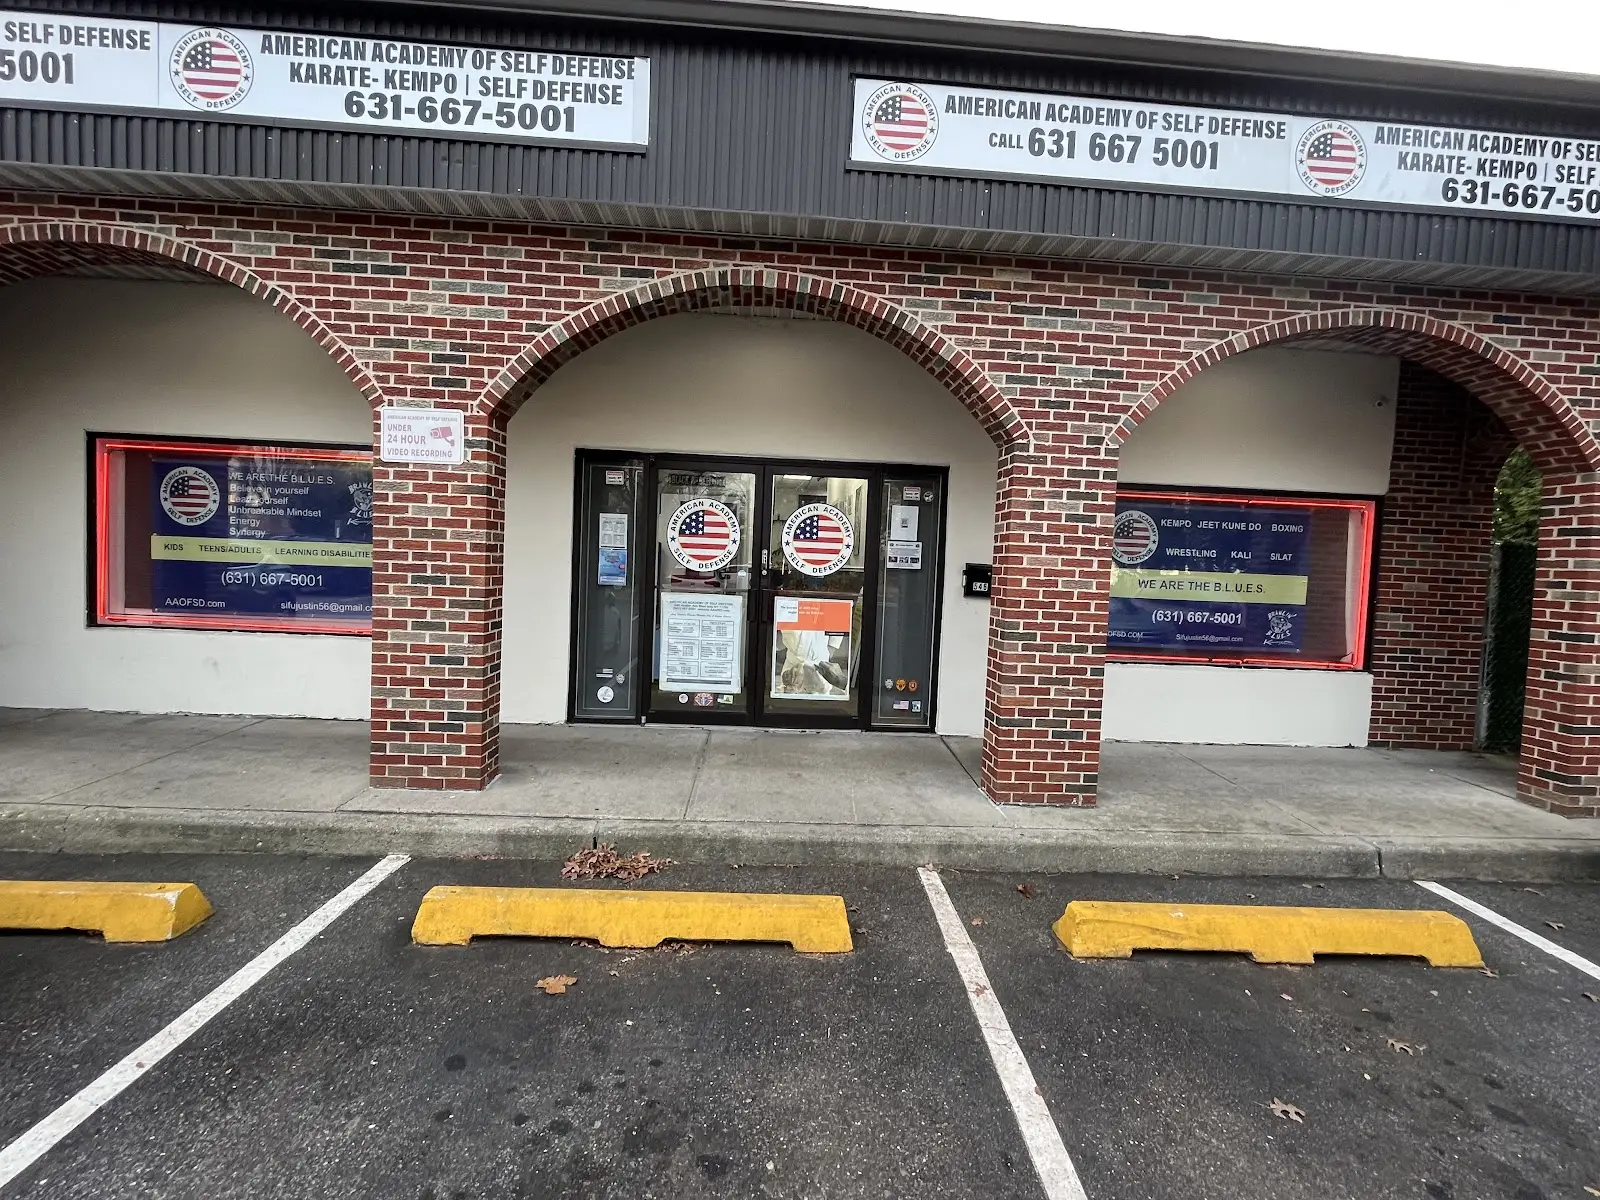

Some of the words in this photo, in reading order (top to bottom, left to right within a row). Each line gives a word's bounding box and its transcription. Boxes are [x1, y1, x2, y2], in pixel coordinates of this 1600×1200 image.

[4, 21, 54, 44] SELF
[59, 24, 151, 50] DEFENSE
[173, 30, 211, 65] AMERICAN
[216, 32, 250, 69] ACADEMY
[260, 34, 367, 61] AMERICAN
[371, 42, 468, 68] ACADEMY
[472, 49, 497, 70] OF
[500, 51, 548, 74] SELF
[552, 55, 635, 80] DEFENSE
[0, 50, 75, 84] 5001
[289, 61, 379, 88] KARATE-
[384, 68, 458, 95] KEMPO
[478, 75, 528, 99] SELF
[532, 79, 623, 105] DEFENSE
[178, 83, 199, 103] SELF
[206, 86, 246, 108] DEFENSE
[866, 85, 902, 118] AMERICAN
[906, 86, 936, 122] ACADEMY
[344, 90, 575, 132] 631-667-5001
[944, 94, 1042, 120] AMERICAN
[1045, 102, 1133, 127] ACADEMY
[1135, 110, 1158, 130] OF
[1161, 112, 1205, 133] SELF
[1208, 116, 1287, 140] DEFENSE
[869, 135, 888, 153] SELF
[894, 138, 931, 159] DEFENSE
[988, 132, 1024, 149] CALL
[1028, 127, 1077, 159] 631
[1088, 132, 1142, 163] 667
[1152, 137, 1219, 170] 5001
[1299, 122, 1333, 154] AMERICAN
[1337, 124, 1365, 158] ACADEMY
[1374, 126, 1464, 151] AMERICAN
[1467, 134, 1549, 158] ACADEMY
[1551, 140, 1572, 159] OF
[1397, 151, 1472, 175] KARATE-
[1476, 157, 1537, 181] KEMPO
[1555, 164, 1597, 185] SELF
[1301, 171, 1319, 189] SELF
[1324, 173, 1359, 193] DEFENSE
[387, 424, 412, 432] UNDER
[387, 434, 398, 443] 24
[400, 435, 426, 445] HOUR
[387, 448, 409, 456] VIDEO
[410, 448, 453, 458] RECORDING
[162, 469, 188, 495] AMERICAN
[193, 470, 218, 496] ACADEMY
[229, 472, 244, 480] WE
[245, 473, 266, 482] ARE
[268, 473, 288, 483] THE
[291, 474, 336, 484] B.L.U.E.S.
[230, 483, 262, 493] Believe
[274, 487, 309, 496] yourself
[167, 507, 183, 520] SELF
[186, 507, 215, 523] DEFENSE
[229, 516, 261, 527] Energy
[230, 505, 285, 516] Unbreakable
[287, 507, 322, 517] Mindset
[670, 501, 704, 531] AMERICAN
[709, 501, 738, 534] ACADEMY
[785, 505, 819, 537] AMERICAN
[823, 506, 852, 539] ACADEMY
[229, 527, 266, 538] Synergy
[1137, 513, 1157, 537] ACADEMY
[1161, 518, 1192, 528] KEMPO
[1197, 520, 1220, 529] JEET
[1222, 521, 1246, 531] KUNE
[1248, 522, 1262, 531] DO
[1271, 524, 1304, 533] BOXING
[164, 543, 184, 551] KIDS
[198, 544, 262, 554] TEENS/ADULTS
[275, 547, 319, 556] LEARNING
[673, 547, 693, 565] SELF
[698, 549, 733, 569] DEFENSE
[1166, 548, 1217, 558] WRESTLING
[1231, 551, 1252, 559] KALI
[1270, 552, 1292, 561] SILAT
[788, 552, 806, 569] SELF
[812, 553, 847, 574] DEFENSE
[221, 571, 256, 587] (631)
[259, 573, 323, 587] 667-5001
[1138, 579, 1157, 589] WE
[1159, 580, 1184, 590] ARE
[1188, 581, 1210, 591] THE
[1213, 582, 1266, 594] B.L.U.E.S.
[165, 598, 226, 608] AAOFSD.com
[1151, 610, 1184, 625] (631)
[1187, 612, 1242, 625] 667-5001
